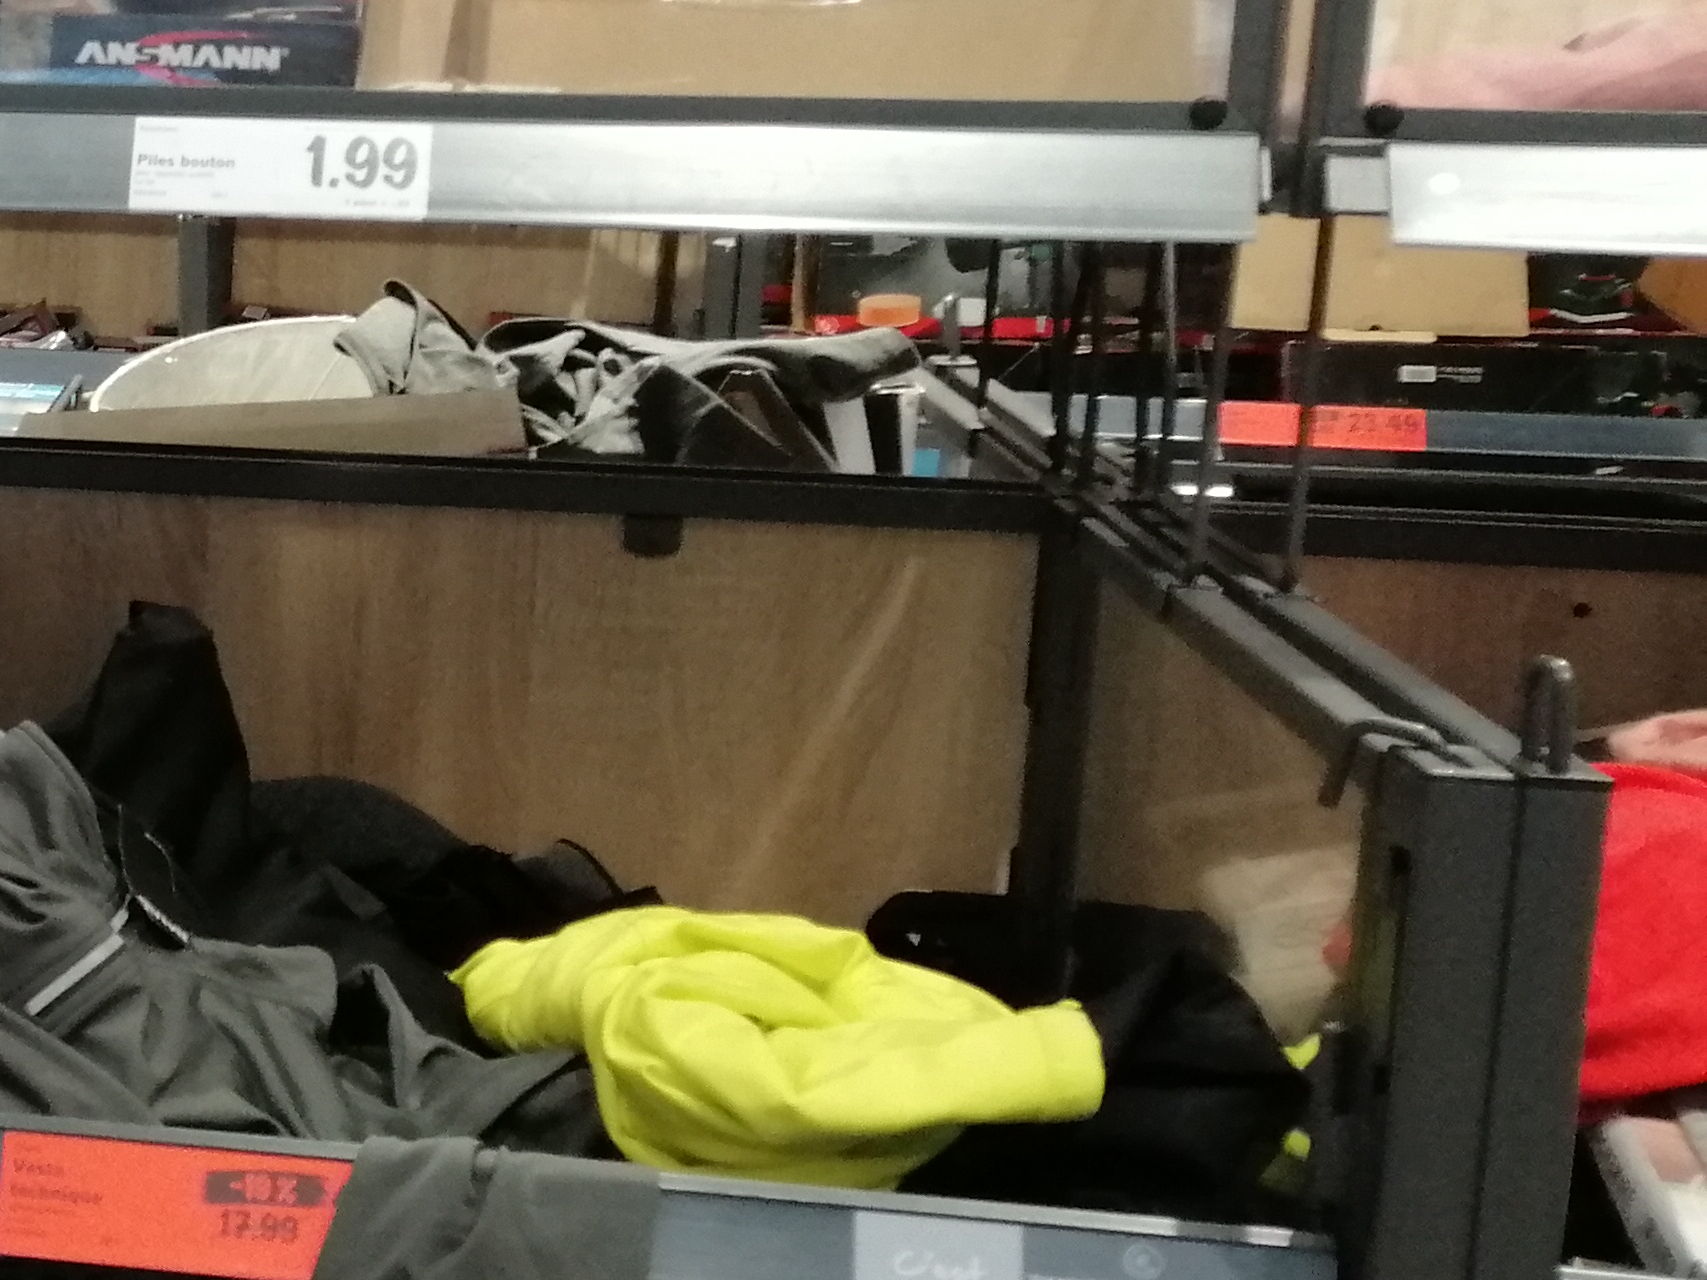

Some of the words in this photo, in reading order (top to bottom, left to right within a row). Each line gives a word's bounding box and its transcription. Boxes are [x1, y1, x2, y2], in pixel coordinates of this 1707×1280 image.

[74, 40, 284, 71] ANSMANN
[137, 153, 174, 168] Piles
[180, 154, 236, 169] bouton
[306, 135, 419, 191] 1.99
[9, 1184, 103, 1206] technique
